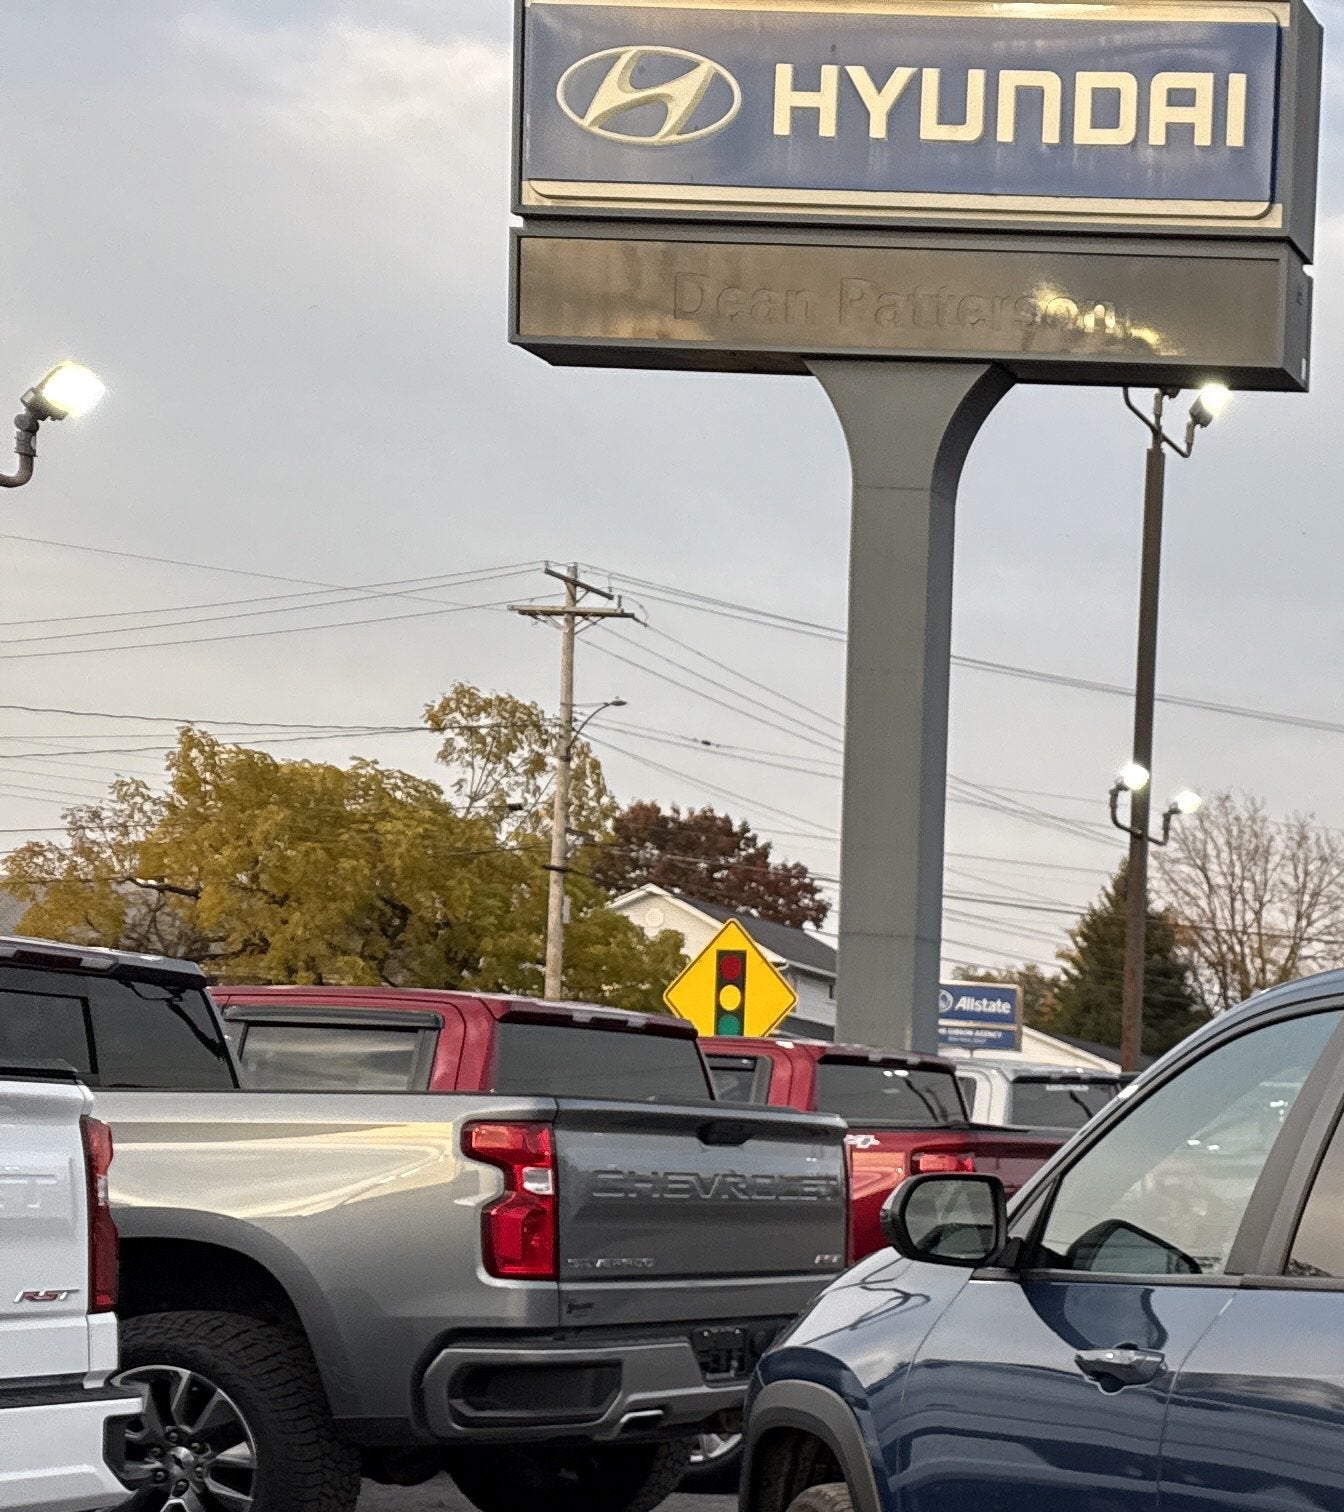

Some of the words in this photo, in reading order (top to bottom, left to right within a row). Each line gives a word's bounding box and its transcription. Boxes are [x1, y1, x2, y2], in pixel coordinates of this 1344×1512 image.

[772, 62, 1248, 147] HYUNDAI
[672, 271, 815, 327] Dean
[954, 995, 1011, 1014] Allstate
[13, 1289, 80, 1304] RST
